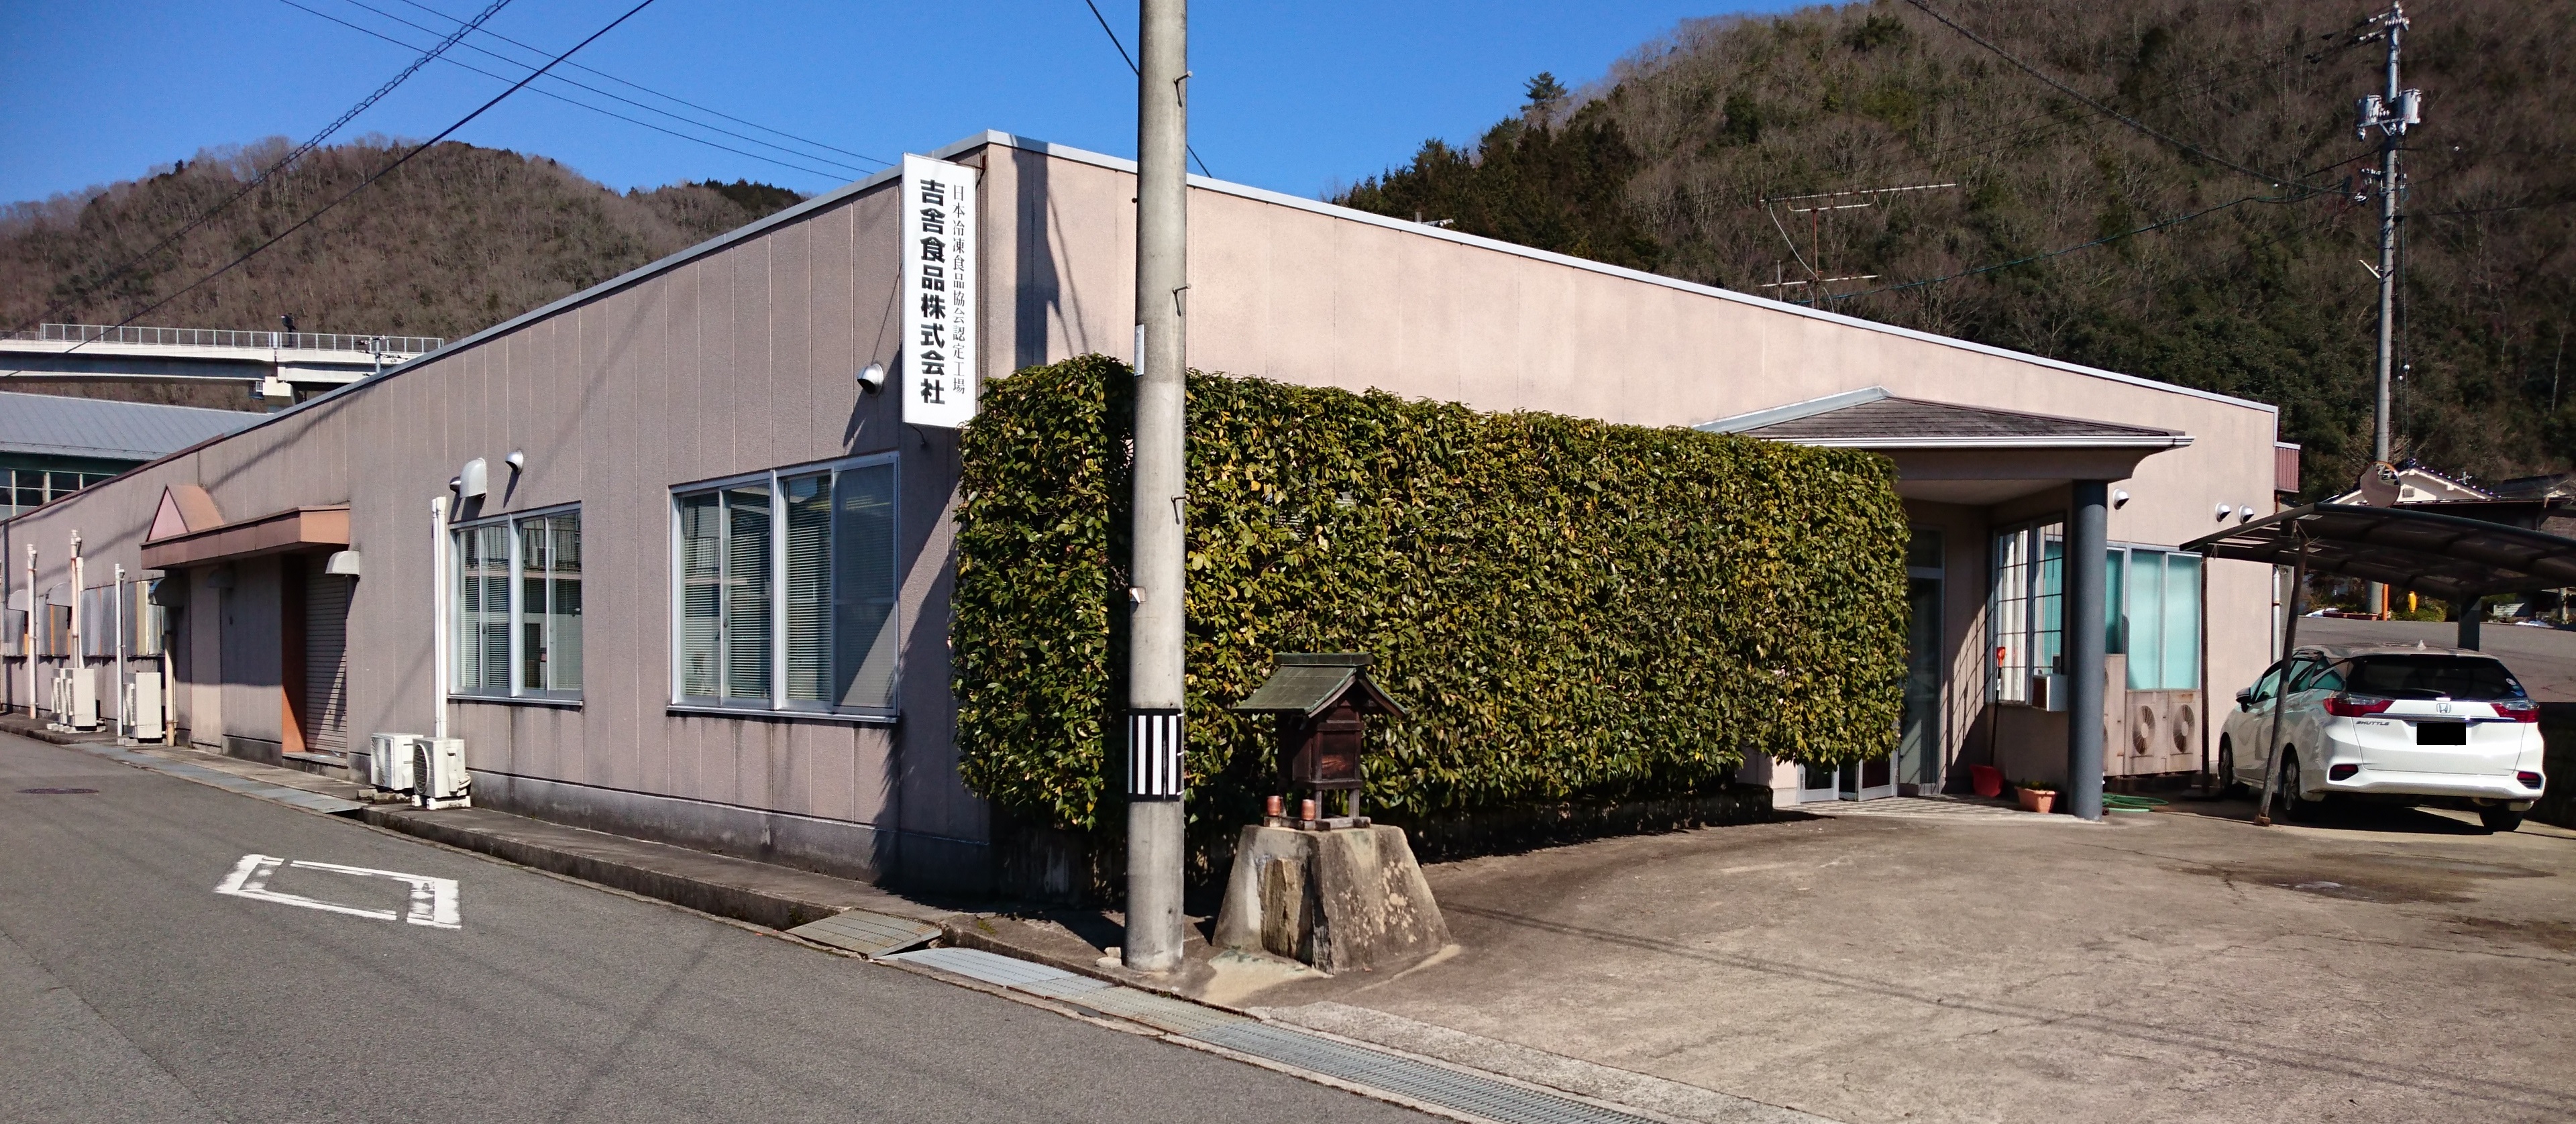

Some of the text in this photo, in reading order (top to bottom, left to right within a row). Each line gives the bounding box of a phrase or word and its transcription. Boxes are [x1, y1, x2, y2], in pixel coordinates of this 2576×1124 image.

[920, 179, 946, 404] 吉舎食品株式会社
[953, 184, 965, 394] 日本冷凍食品協会認定工場
